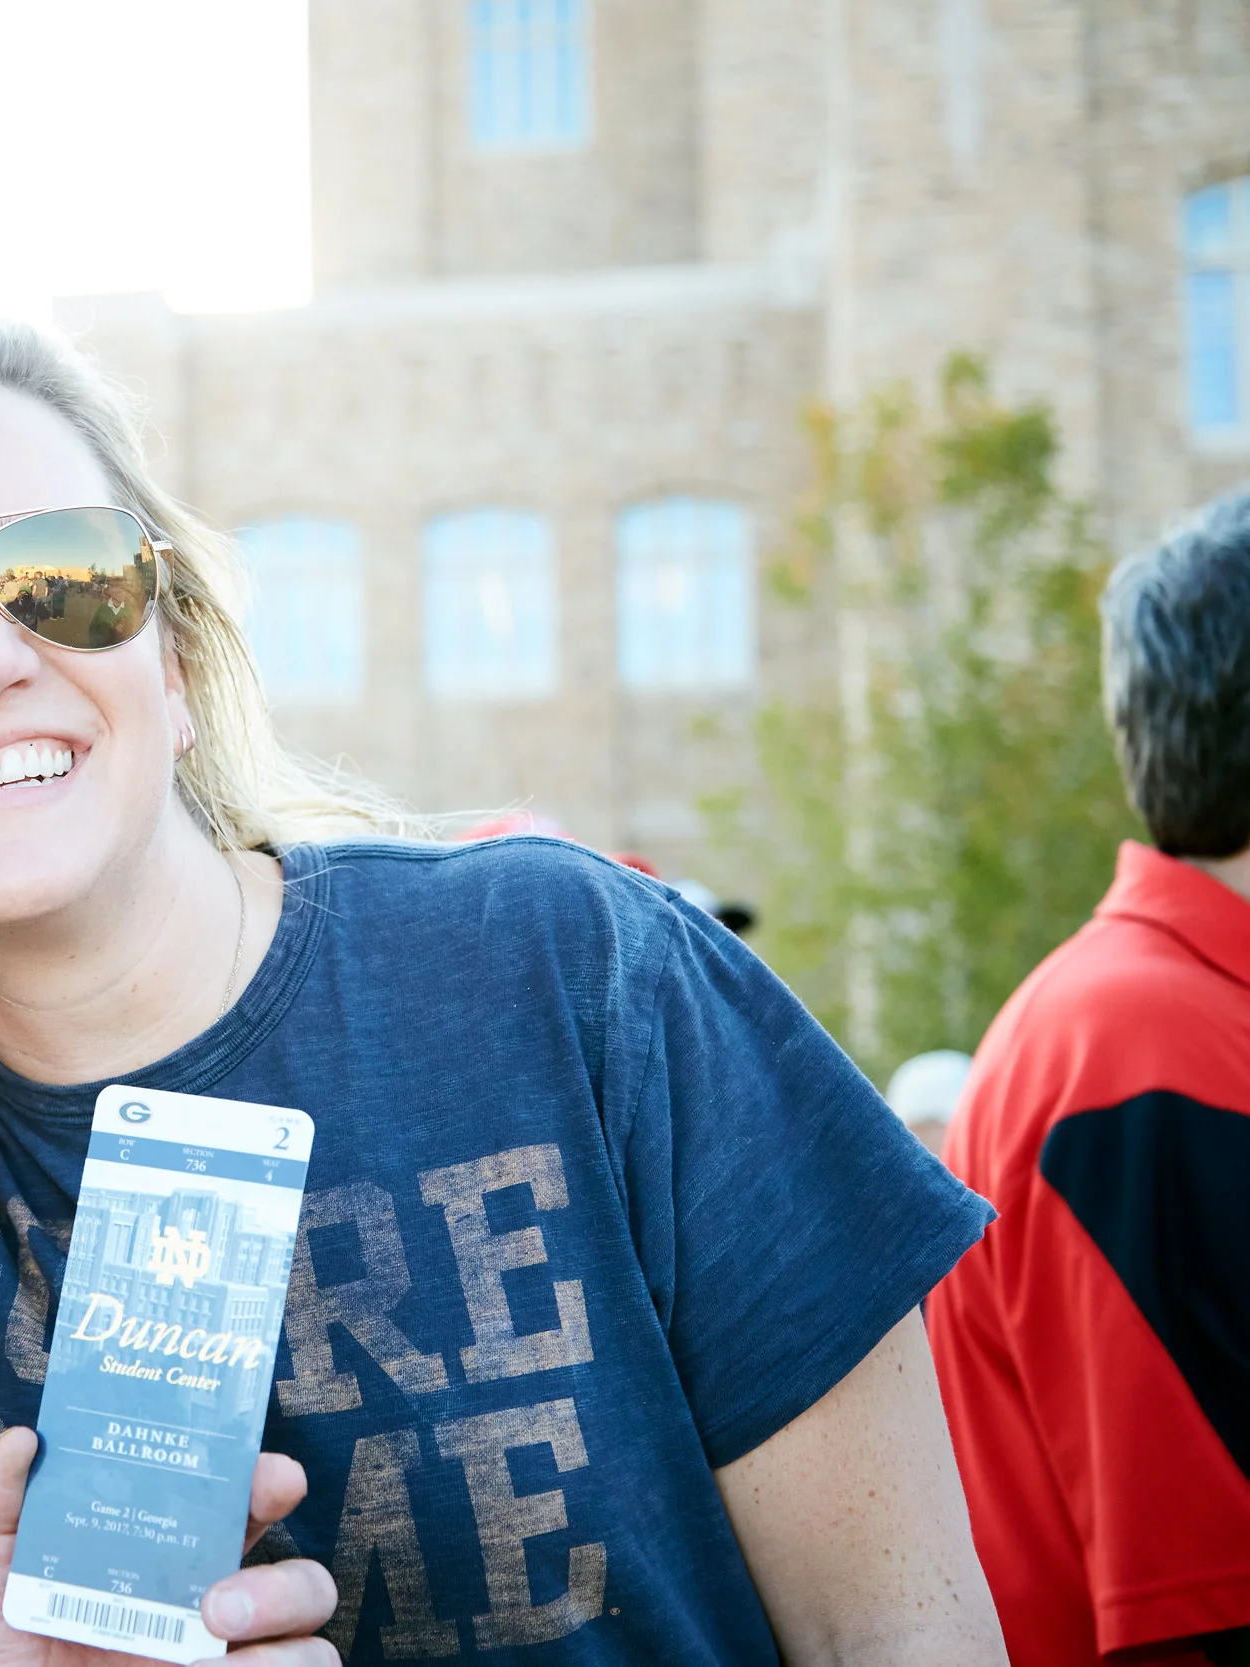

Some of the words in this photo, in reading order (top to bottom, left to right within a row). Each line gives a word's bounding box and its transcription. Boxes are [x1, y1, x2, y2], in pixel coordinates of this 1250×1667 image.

[269, 1115, 301, 1126] GAME
[118, 1138, 136, 1147] ROW
[183, 1147, 214, 1158] SECTION
[263, 1159, 280, 1168] SEAT
[273, 1126, 290, 1151] 2
[119, 1149, 131, 1161] C
[185, 1158, 207, 1172] 736
[264, 1171, 273, 1182] 4
[69, 1292, 264, 1370] Duncan
[100, 1355, 163, 1382] Student
[166, 1367, 221, 1392] Center
[108, 1421, 190, 1449] DAHNKE
[91, 1437, 199, 1468] BALLROOM
[65, 1512, 89, 1529] Sept.
[91, 1518, 101, 1530] 9,
[103, 1520, 130, 1536] 2017,
[132, 1525, 155, 1539] 7:30
[156, 1531, 179, 1545] p.m.
[182, 1534, 200, 1548] ET
[91, 1501, 121, 1517] Game
[122, 1507, 130, 1519] 2
[138, 1510, 178, 1529] Georgia
[42, 1554, 60, 1564] ROW
[107, 1567, 140, 1581] SECTION
[43, 1566, 55, 1579] C
[110, 1579, 133, 1595] 736
[191, 1596, 200, 1609] 4
